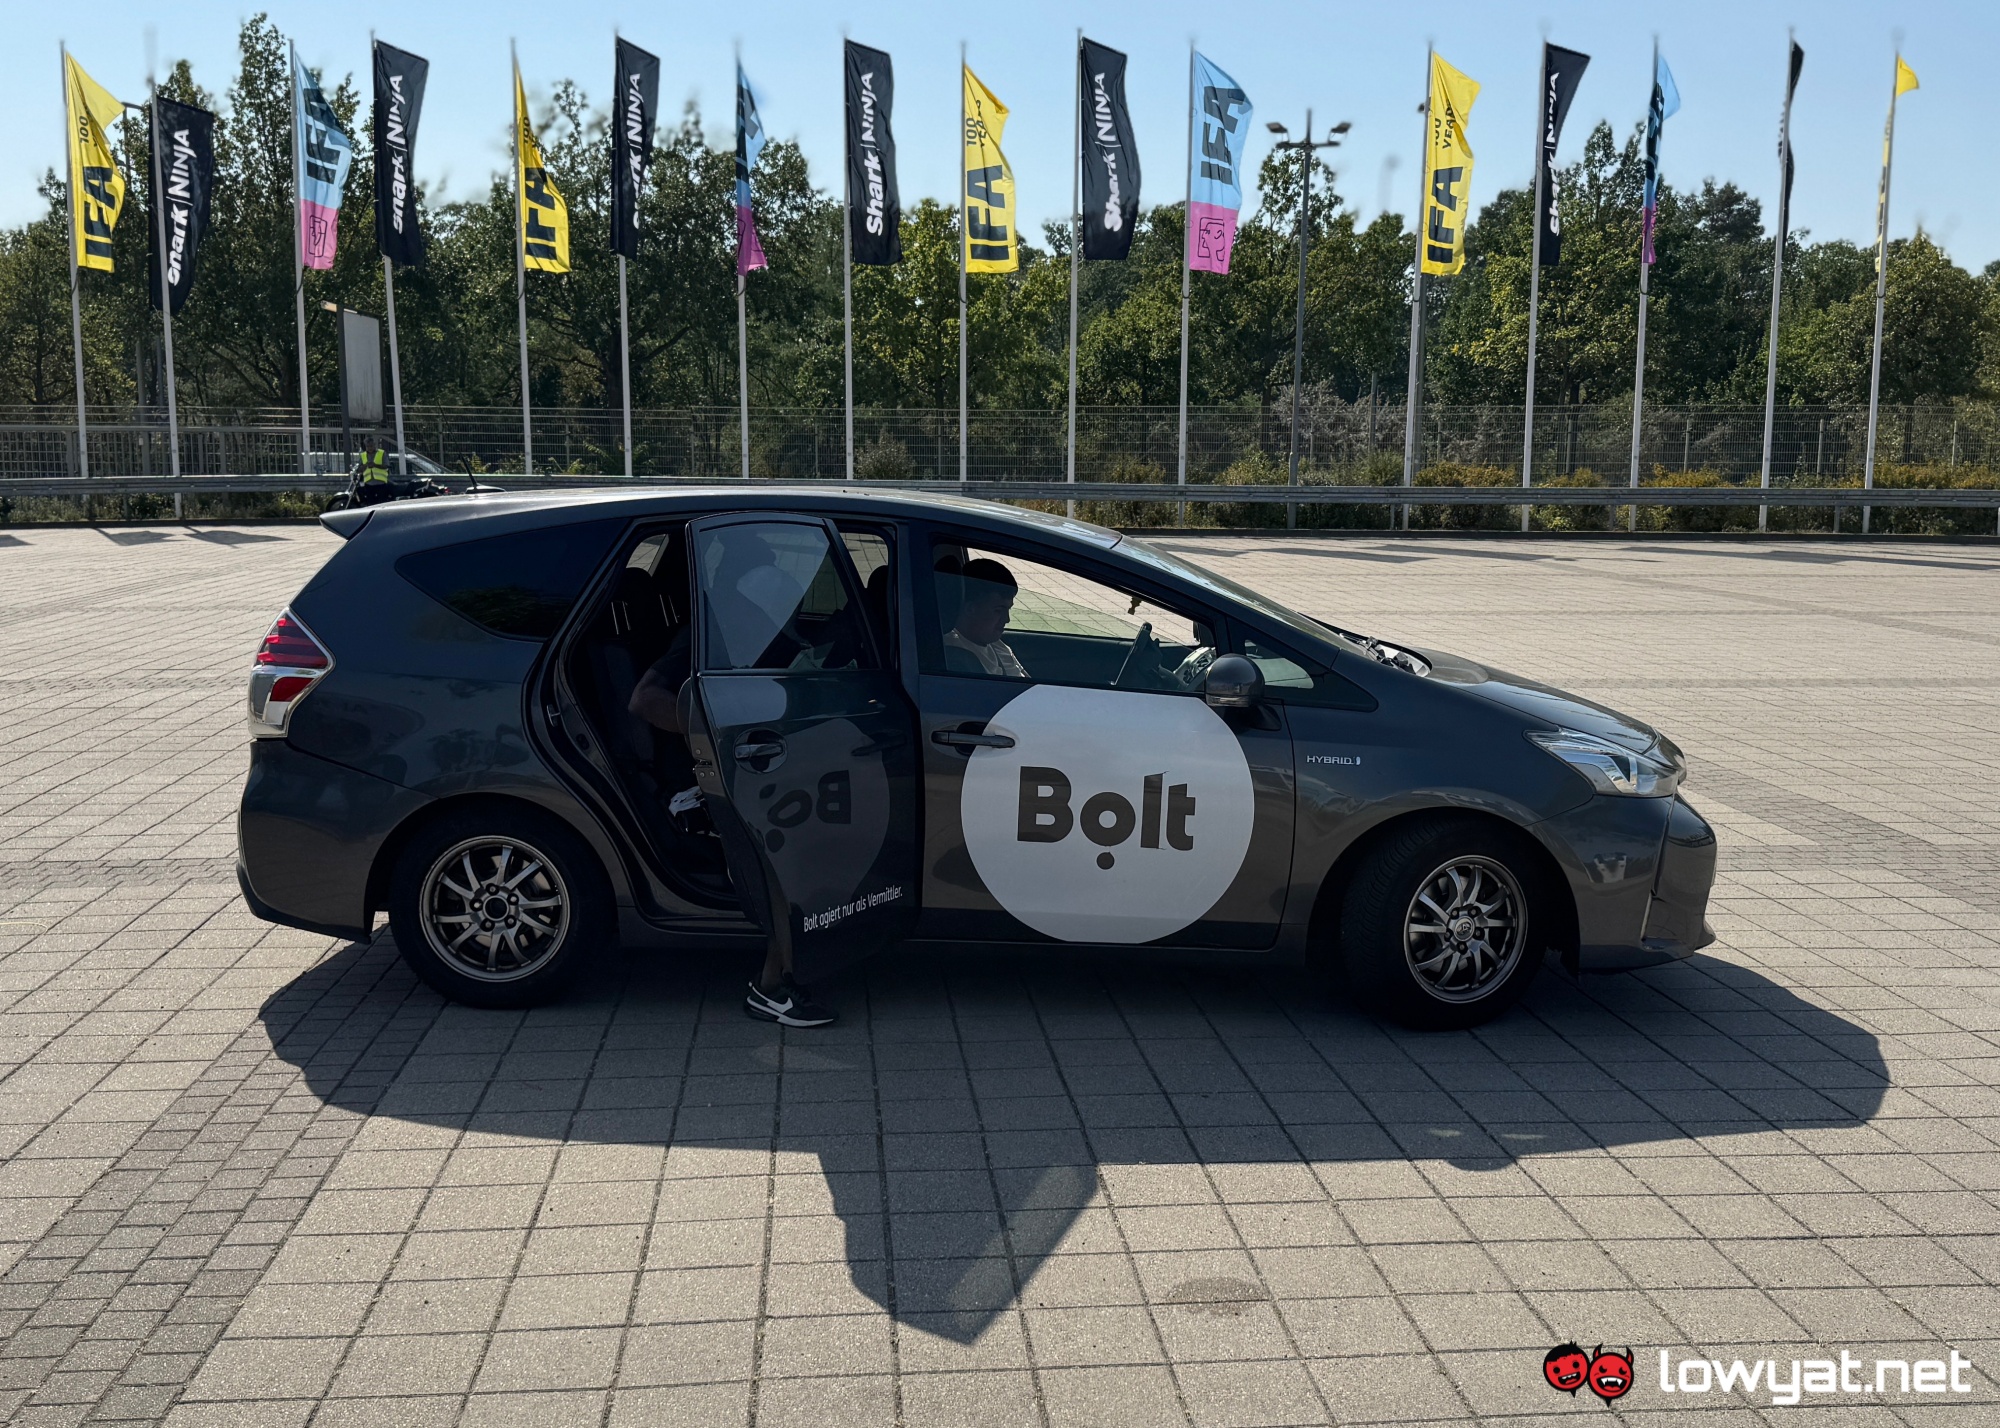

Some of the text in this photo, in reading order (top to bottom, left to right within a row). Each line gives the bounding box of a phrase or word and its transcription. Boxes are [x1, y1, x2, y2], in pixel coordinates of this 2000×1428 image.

[303, 88, 346, 185] IFA
[966, 117, 977, 147] 100
[1201, 86, 1246, 185] IFA
[83, 166, 116, 258] IFA
[525, 167, 557, 260] IFA
[967, 164, 1010, 261] IFA
[1427, 166, 1463, 264] IFA
[1306, 755, 1354, 766] HYBRID
[1017, 766, 1196, 870] Bolt
[804, 913, 818, 933] Bolt
[819, 906, 841, 929] agiert
[842, 902, 855, 918] nur
[856, 896, 867, 912] als
